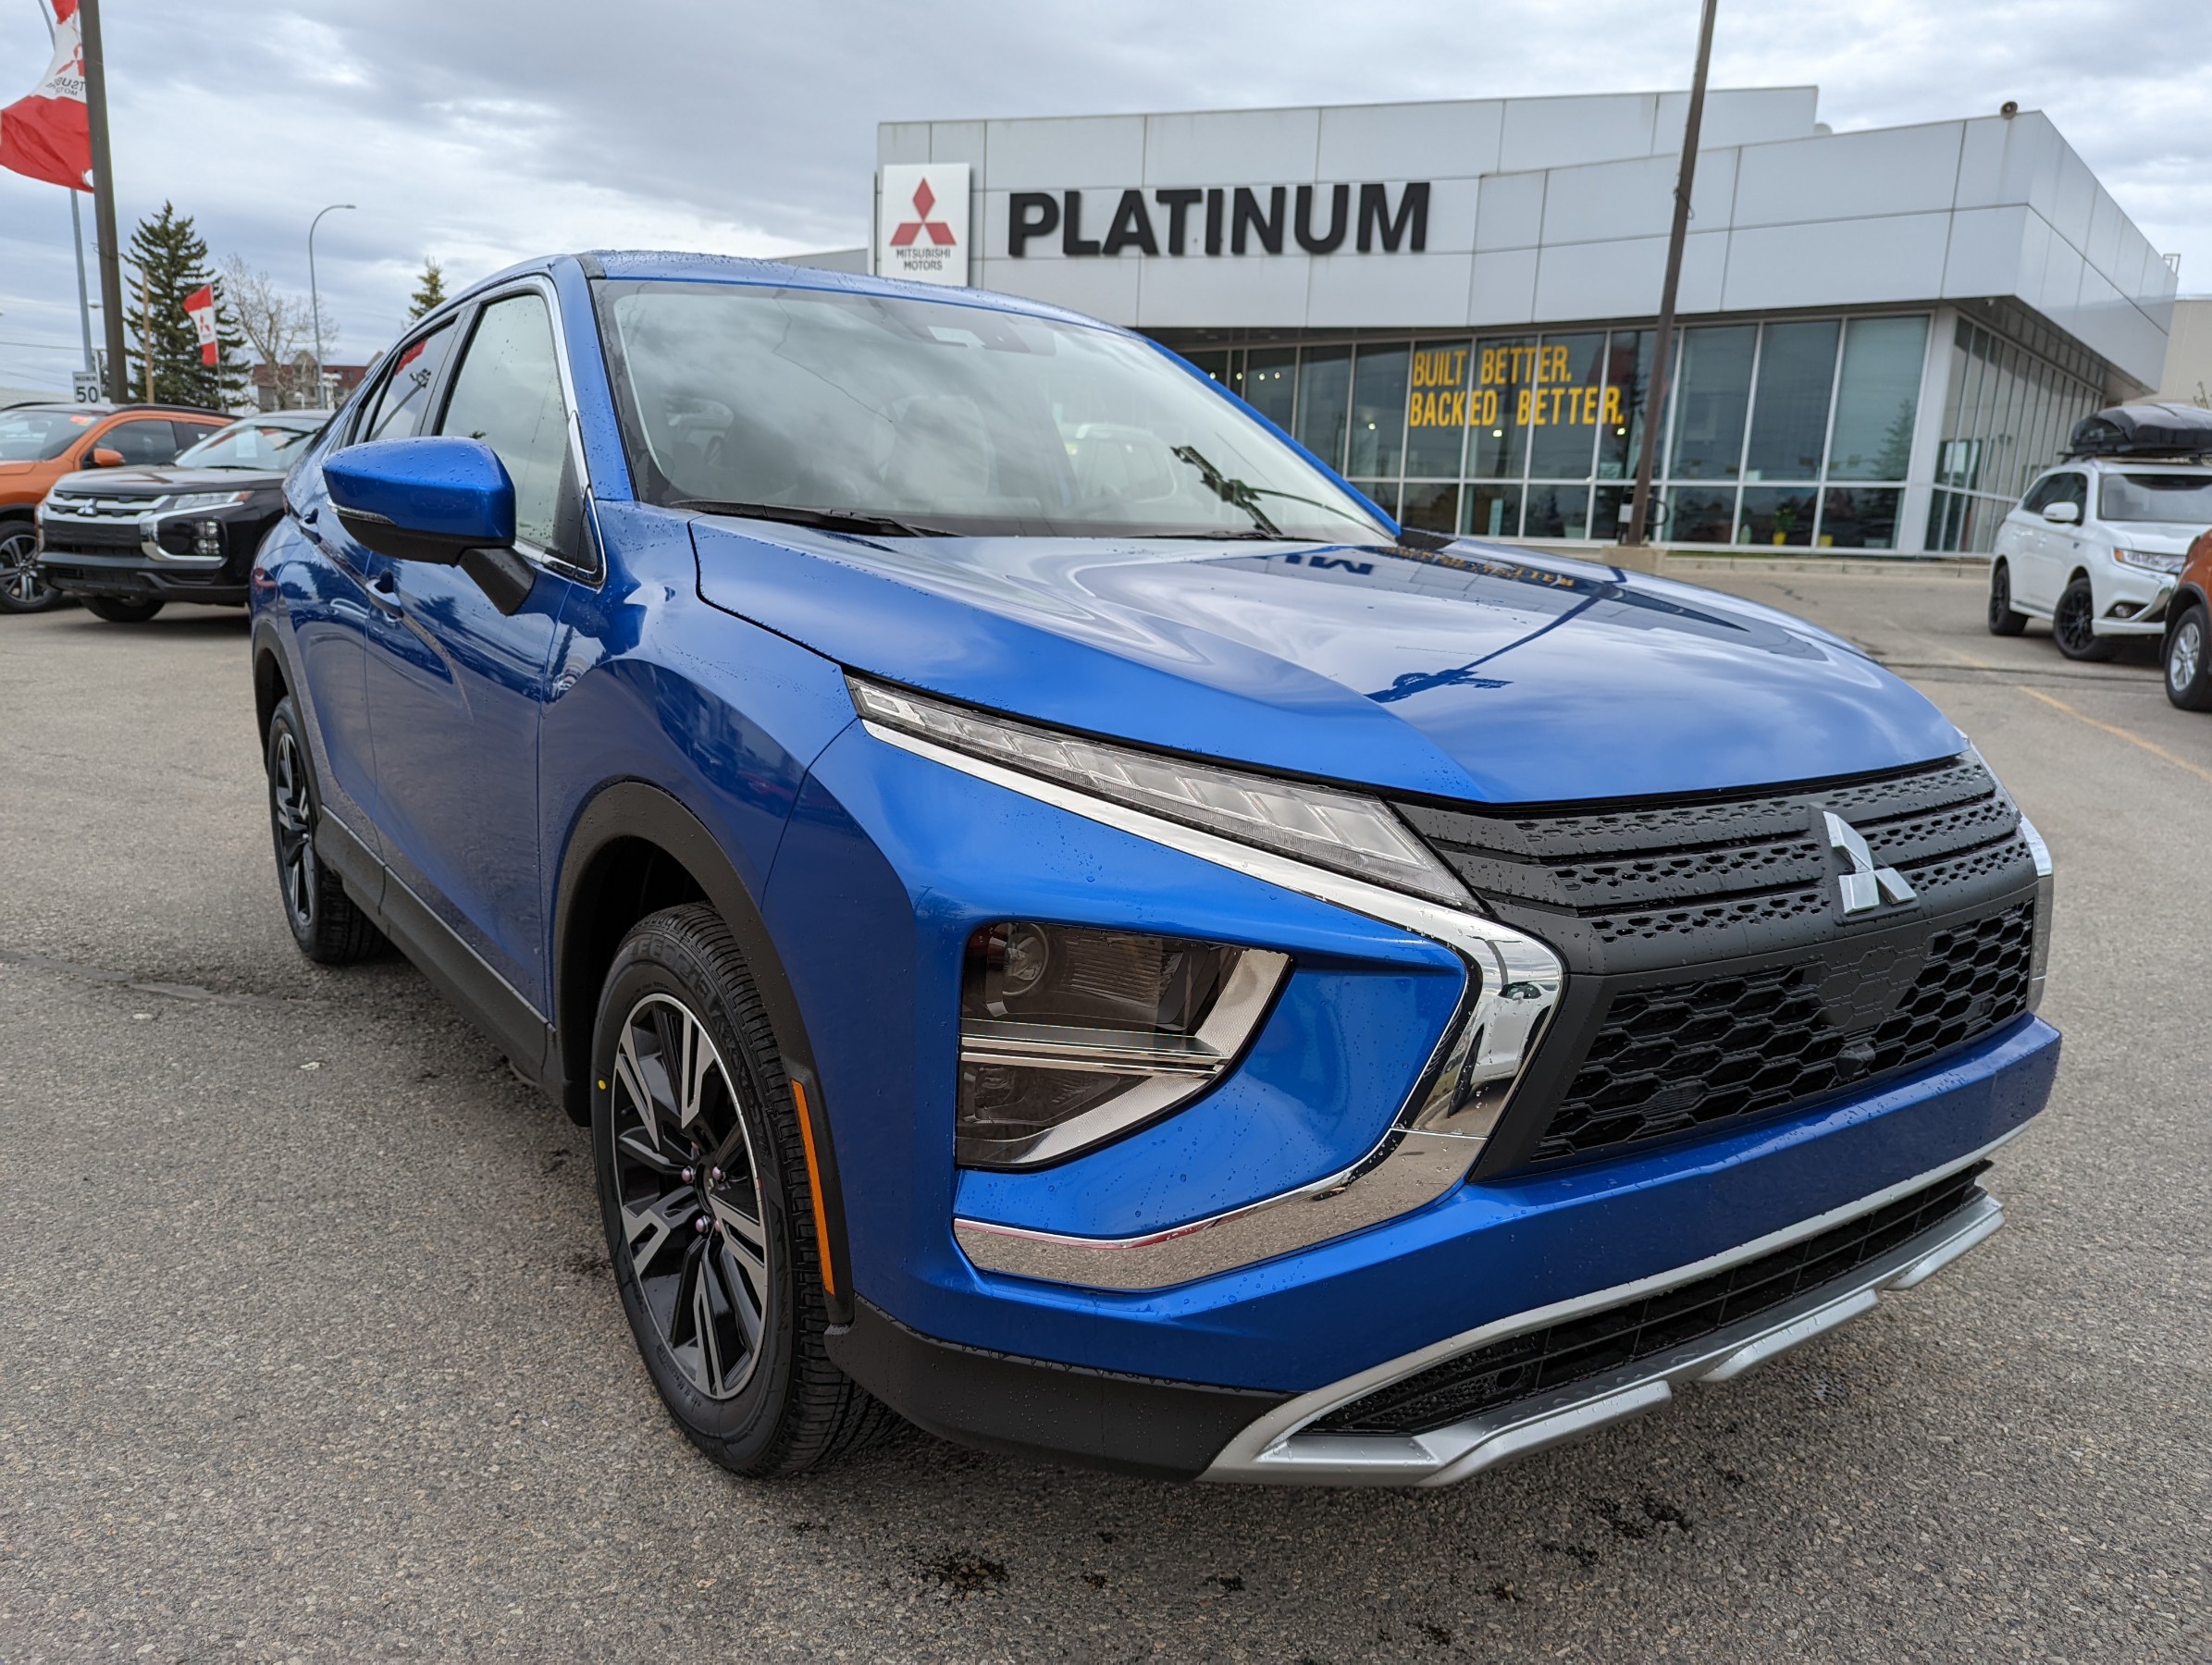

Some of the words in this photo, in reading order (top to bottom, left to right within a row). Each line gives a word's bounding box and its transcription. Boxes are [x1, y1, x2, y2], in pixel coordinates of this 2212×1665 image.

[1007, 181, 1430, 257] PLATINUM
[896, 248, 951, 259] MITSUBISHI
[904, 260, 943, 271] MOTORS
[1412, 350, 1467, 388] BUILT
[1480, 345, 1572, 385] BETTER.
[76, 386, 98, 403] 50
[1408, 388, 1499, 427] BACKED
[1515, 385, 1625, 426] BETTER.
